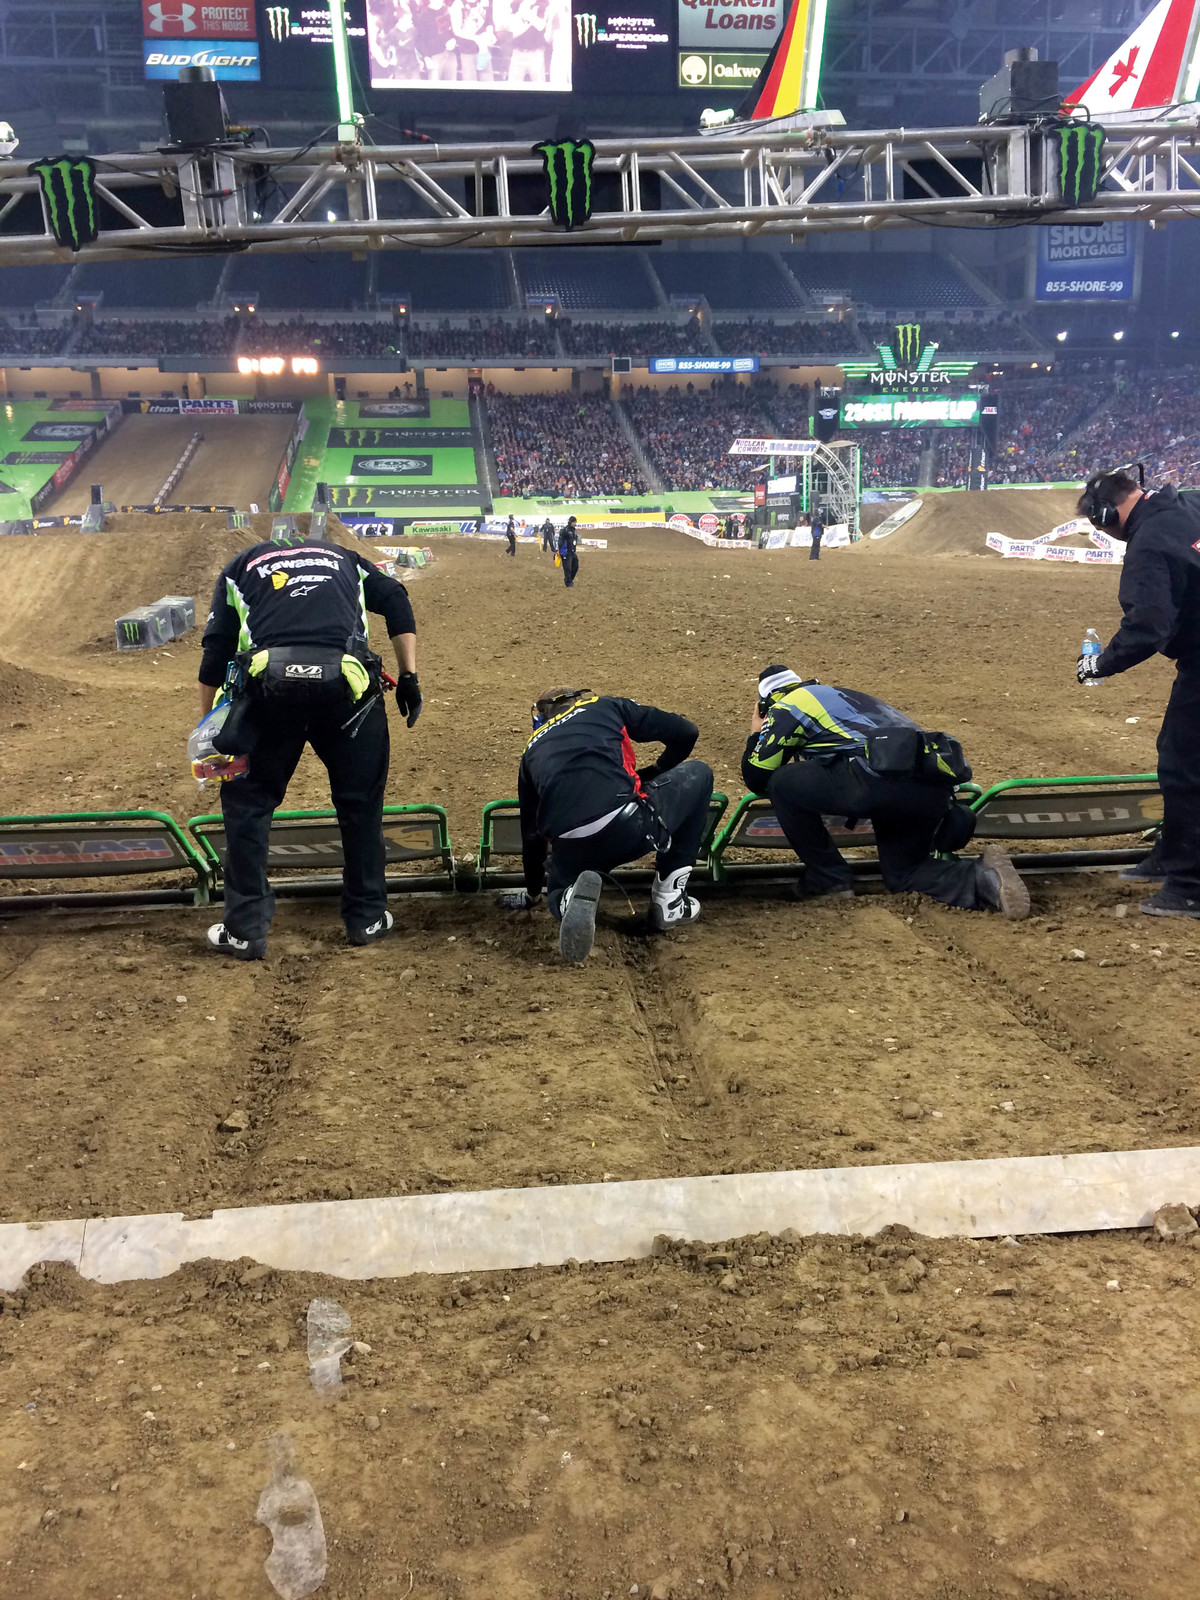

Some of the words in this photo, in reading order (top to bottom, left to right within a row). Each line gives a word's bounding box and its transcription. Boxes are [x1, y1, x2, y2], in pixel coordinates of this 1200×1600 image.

[201, 7, 248, 20] PROTECT
[705, 9, 776, 30] Loans
[203, 21, 220, 31] THIS
[146, 53, 191, 66] BUD
[202, 54, 257, 67] LIGHT
[714, 62, 761, 78] Oakwo
[1050, 222, 1125, 246] SHORE
[1050, 243, 1125, 259] MORTGAGE
[1045, 280, 1124, 292] 855-SHORE-99
[678, 361, 731, 370] 855-SHORE-99
[870, 371, 951, 386] MONSTER
[149, 405, 179, 413] thor
[182, 400, 235, 409] PARTS
[379, 489, 481, 497] MONSTER
[1057, 521, 1077, 534] PARTS
[1092, 531, 1111, 549] PARTS
[1046, 547, 1075, 556] PARTS
[1085, 550, 1114, 558] PARTS
[256, 557, 340, 579] Kawasaki
